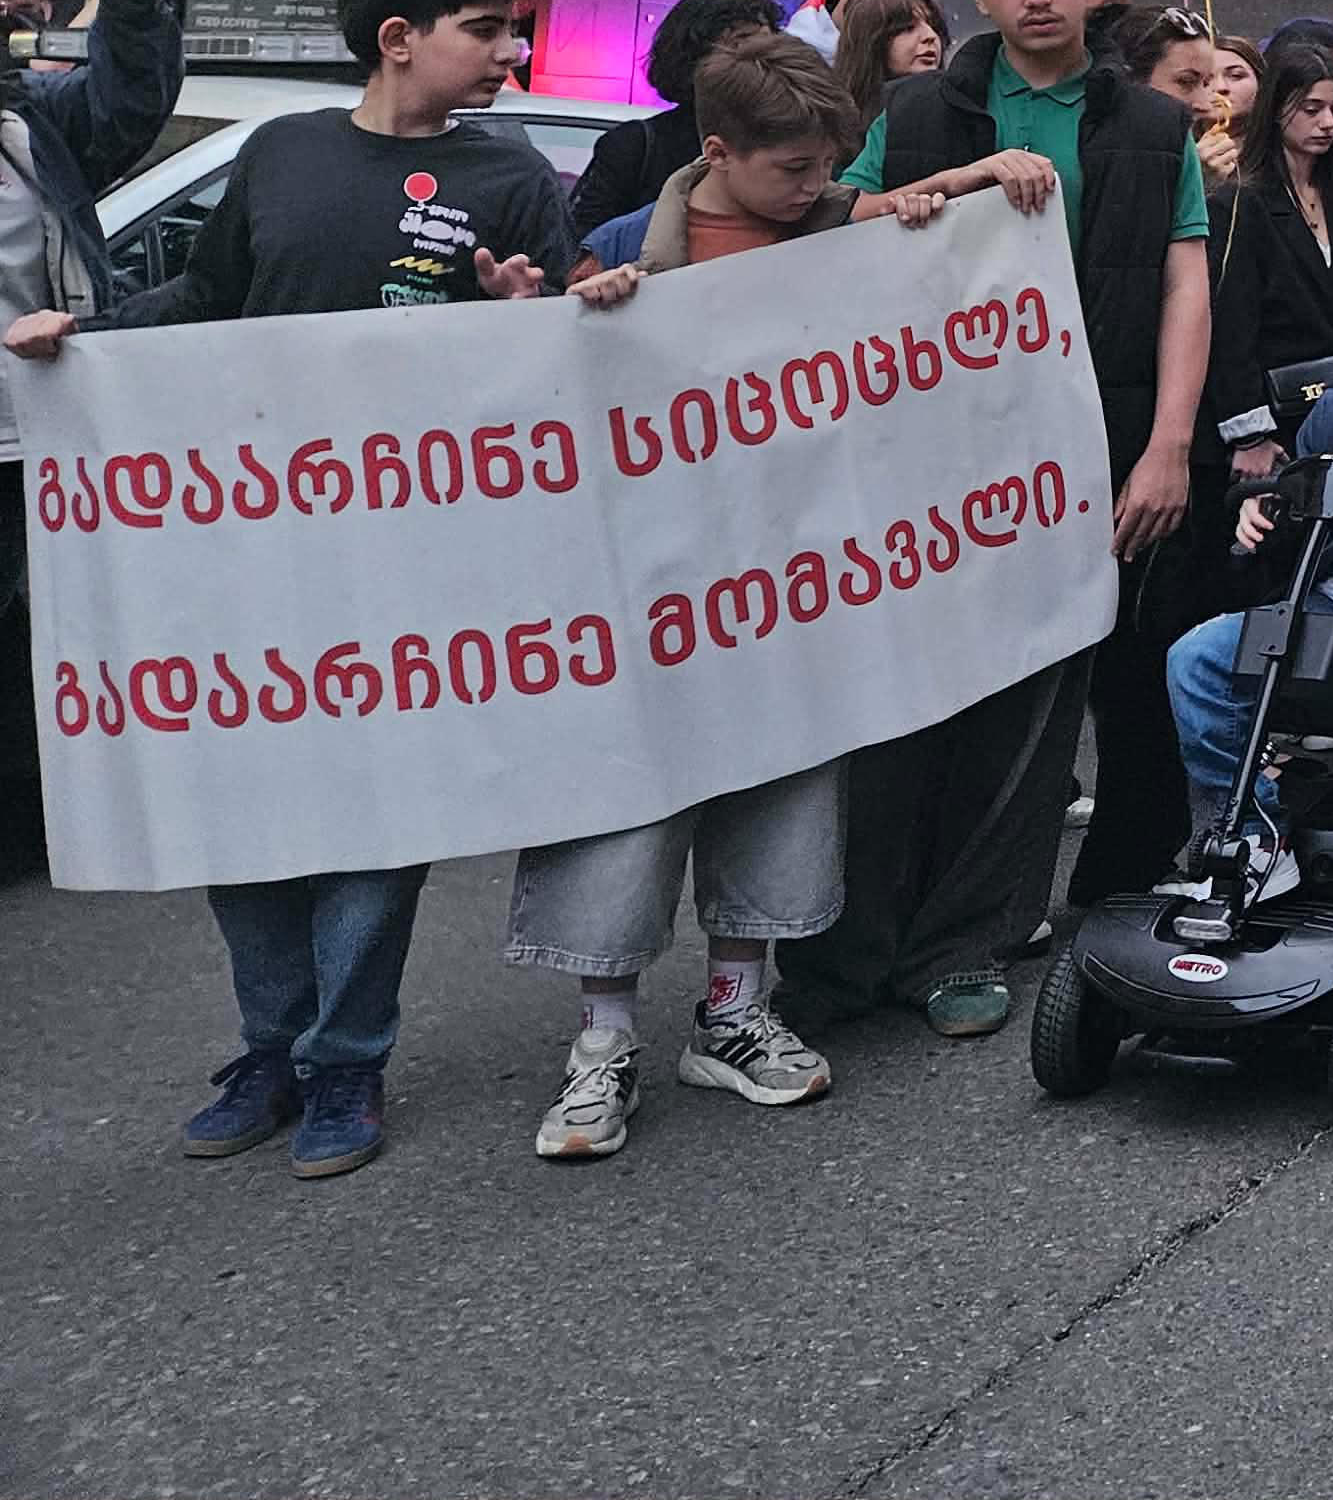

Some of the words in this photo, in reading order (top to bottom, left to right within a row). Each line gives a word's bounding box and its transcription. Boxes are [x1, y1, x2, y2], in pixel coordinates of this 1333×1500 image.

[37, 420, 578, 534] გადაარჩინე
[608, 285, 1073, 479] სიცოცხლე,
[54, 612, 617, 738] გადაარჩინე
[648, 460, 1091, 668] მომავალი.
